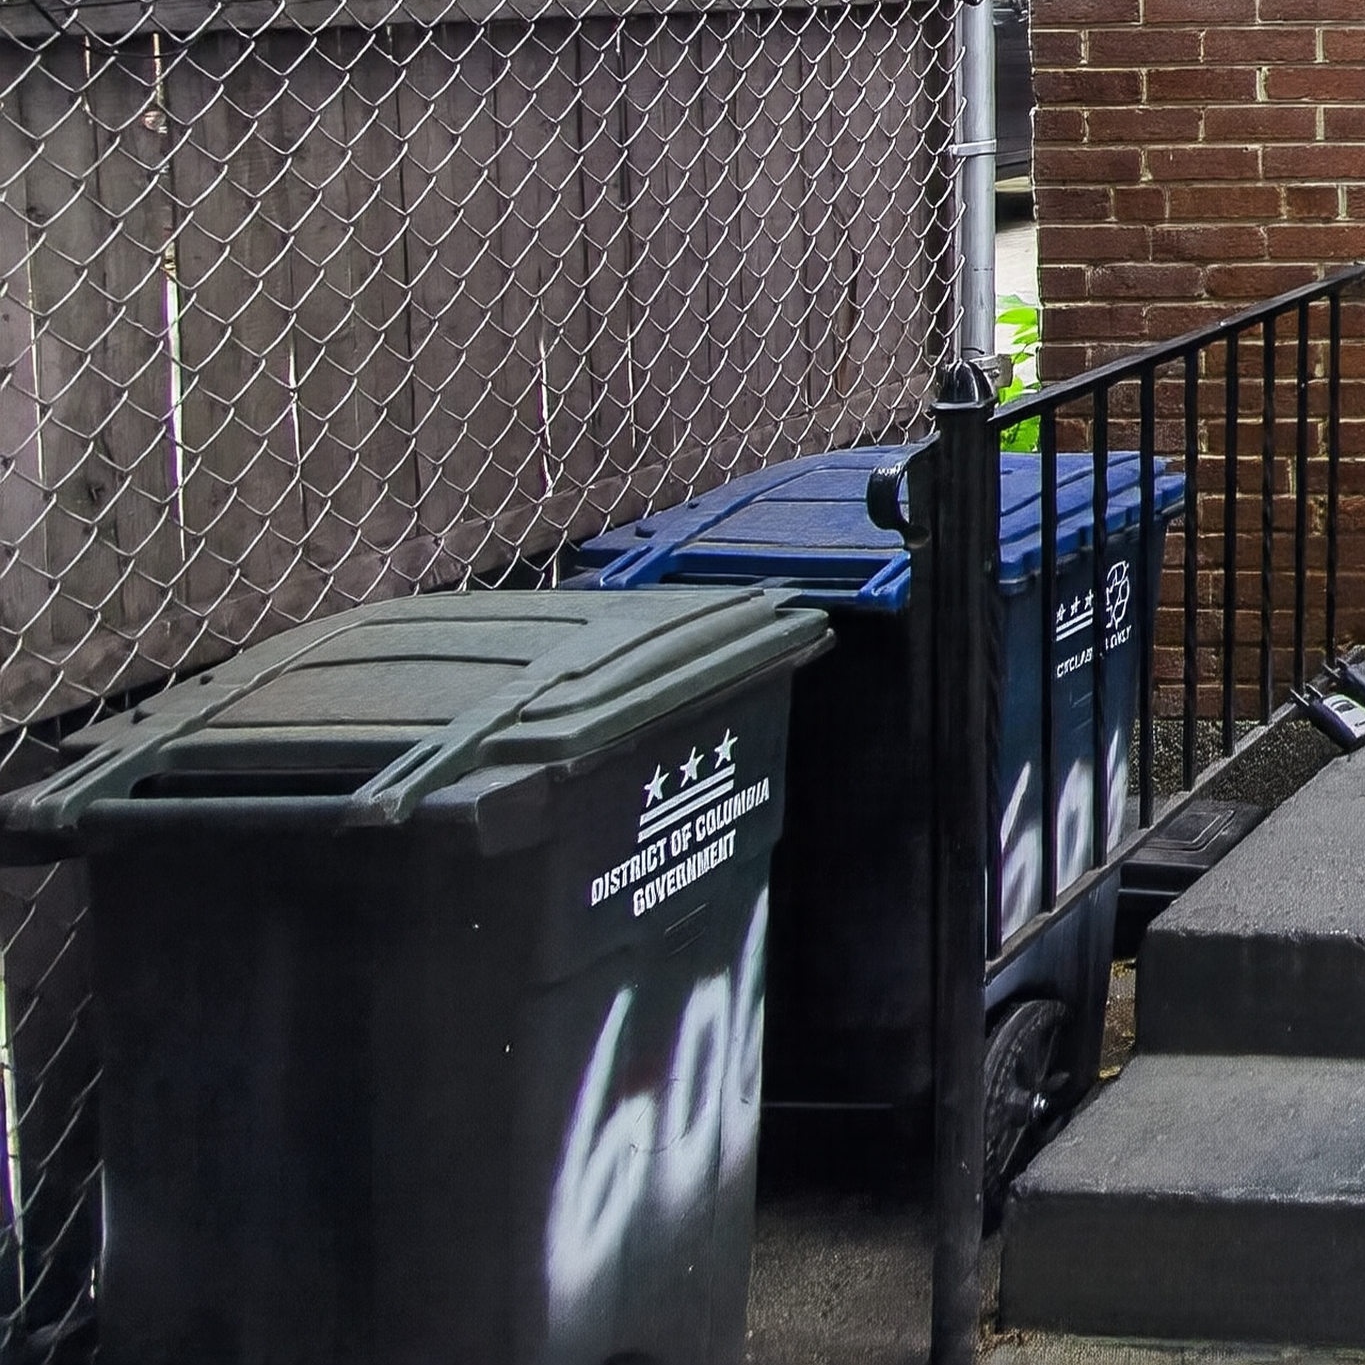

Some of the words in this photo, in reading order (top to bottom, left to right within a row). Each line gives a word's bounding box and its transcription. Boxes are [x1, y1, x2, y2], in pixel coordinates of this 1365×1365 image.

[590, 837, 667, 907] DISTRICT
[670, 821, 693, 858] OF
[695, 777, 770, 843] COLUMBIA
[632, 828, 737, 917] GOVERNMENT
